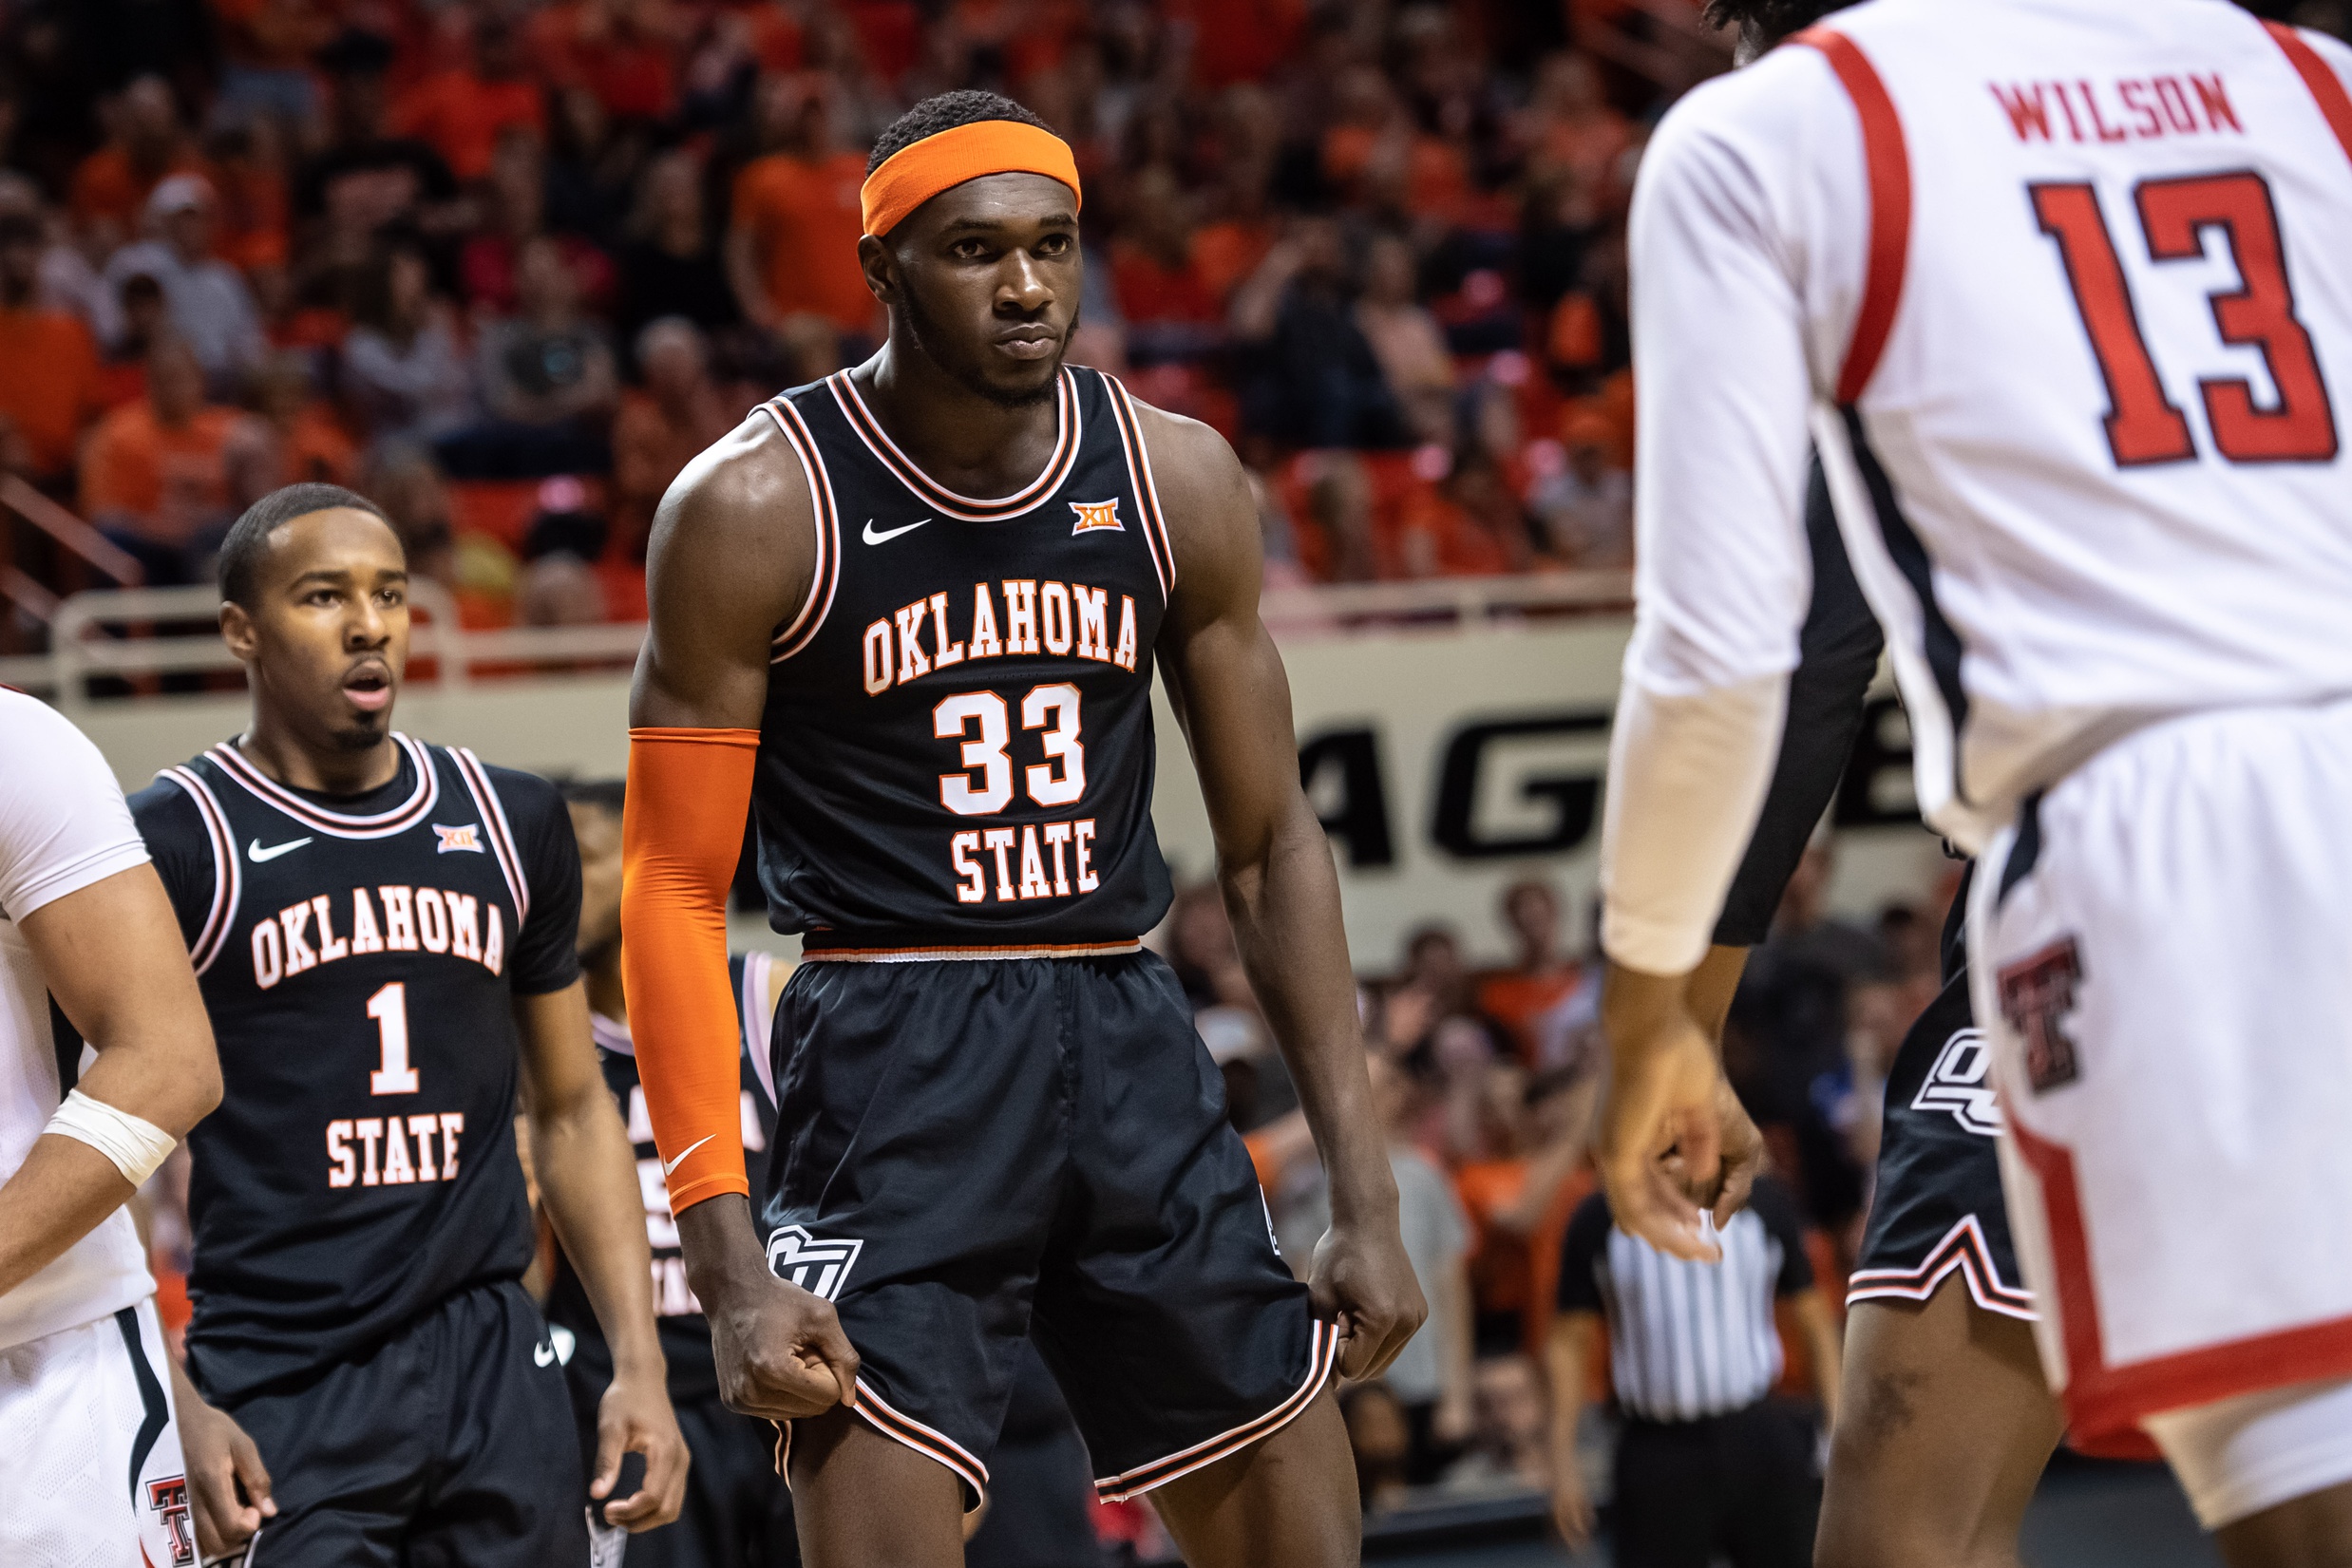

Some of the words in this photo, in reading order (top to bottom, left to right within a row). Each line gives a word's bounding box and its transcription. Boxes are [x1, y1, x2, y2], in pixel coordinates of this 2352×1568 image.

[1989, 71, 2244, 144] WILSON
[2025, 168, 2340, 467] 13
[1072, 501, 1121, 531] XII
[862, 579, 1137, 697] OKLAHOMA
[932, 682, 1087, 815] 33
[950, 819, 1100, 904] STATE
[251, 885, 504, 991] OKLAHOMA
[367, 982, 419, 1096] 1
[326, 1113, 465, 1188] STATE
